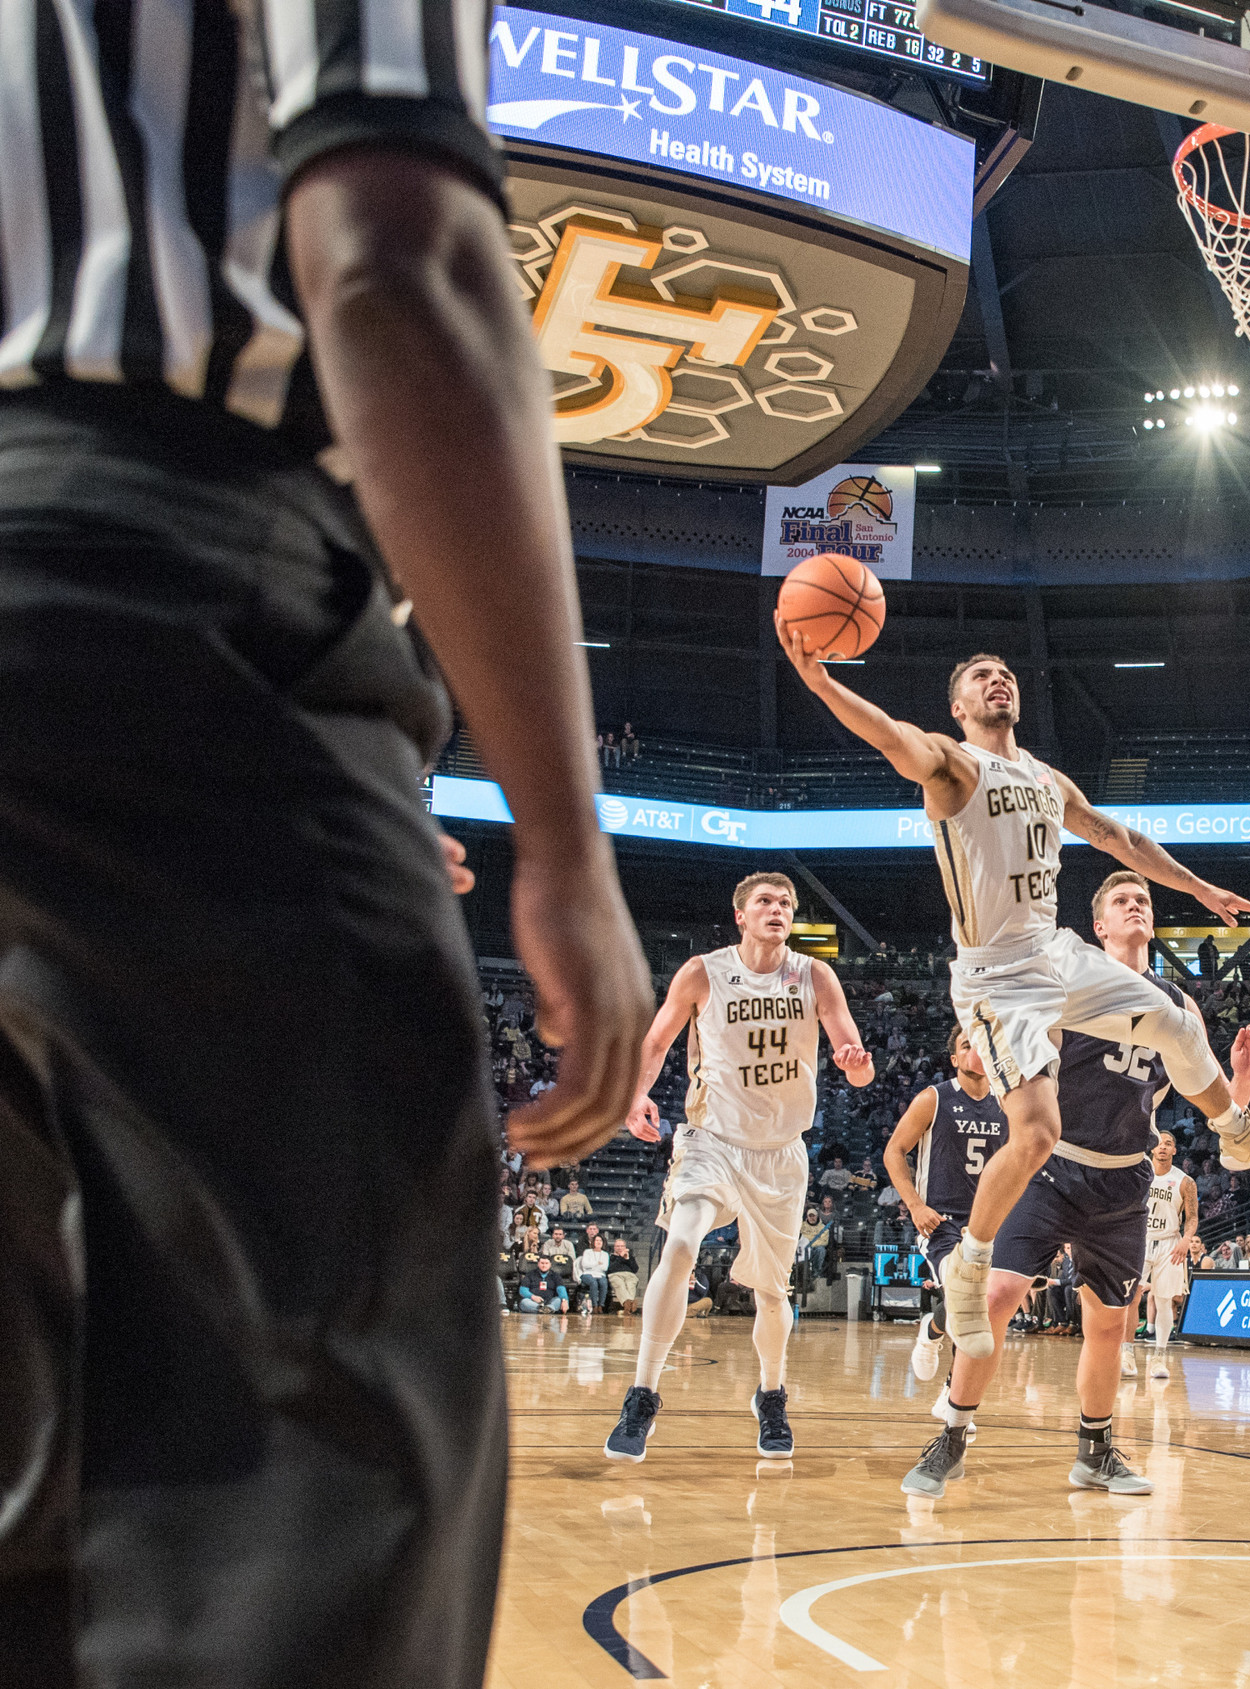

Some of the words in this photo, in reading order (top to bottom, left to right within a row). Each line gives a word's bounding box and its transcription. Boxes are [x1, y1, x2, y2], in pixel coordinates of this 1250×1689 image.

[869, 2, 887, 20] FT
[824, 16, 849, 38] TOL
[849, 23, 860, 40] 2
[868, 28, 897, 50] REB
[905, 38, 920, 56] 16
[650, 129, 735, 174] Health
[741, 152, 830, 200] System
[782, 507, 825, 519] NCAA
[780, 520, 853, 545] Final
[855, 524, 873, 533] San
[855, 533, 894, 542] Antonio
[787, 548, 814, 558] 2004
[816, 542, 882, 563] Four
[987, 785, 1060, 818] GEORGIA
[632, 809, 684, 831] AT&T
[1124, 811, 1168, 835] the
[1026, 822, 1047, 860] 10
[1009, 867, 1057, 903] TECH
[727, 997, 804, 1024] GEORGIA
[748, 1027, 787, 1058] 44
[739, 1059, 799, 1087] TECH
[1103, 1043, 1157, 1082] 32
[955, 1120, 1000, 1136] YALE
[965, 1138, 987, 1175] 5
[1122, 1278, 1137, 1298] Y
